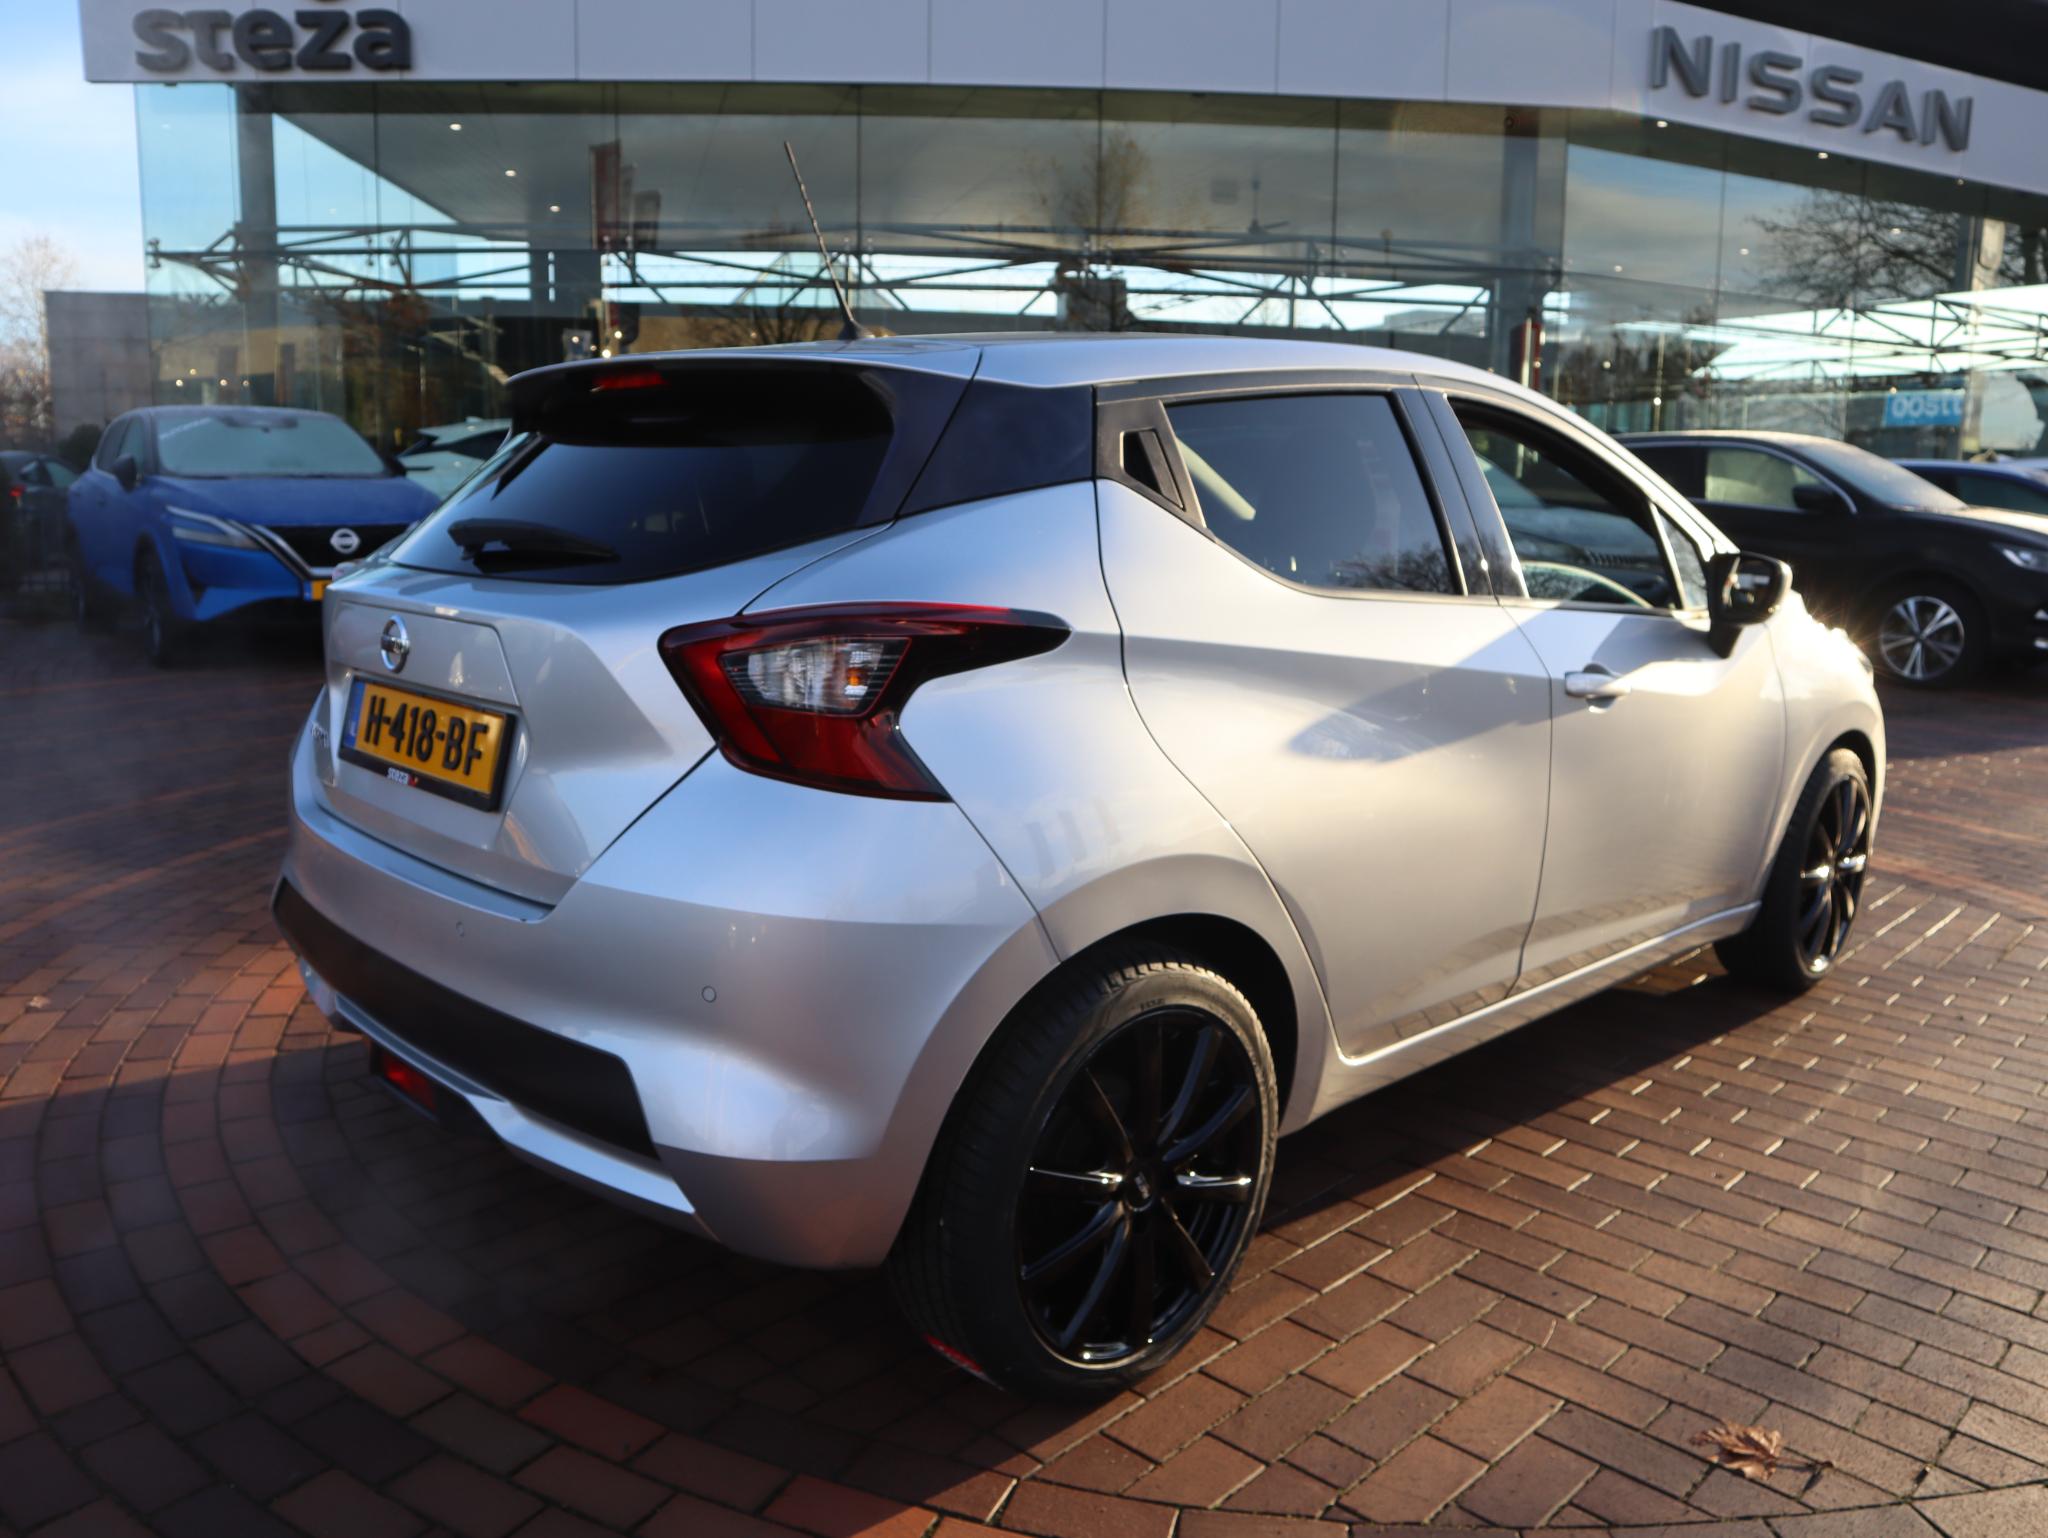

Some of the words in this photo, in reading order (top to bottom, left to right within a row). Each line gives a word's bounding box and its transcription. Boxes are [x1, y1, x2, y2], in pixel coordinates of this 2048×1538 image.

[132, 8, 413, 73] steza
[1650, 24, 1974, 152] NISSAN
[363, 694, 489, 777] H-418-BF
